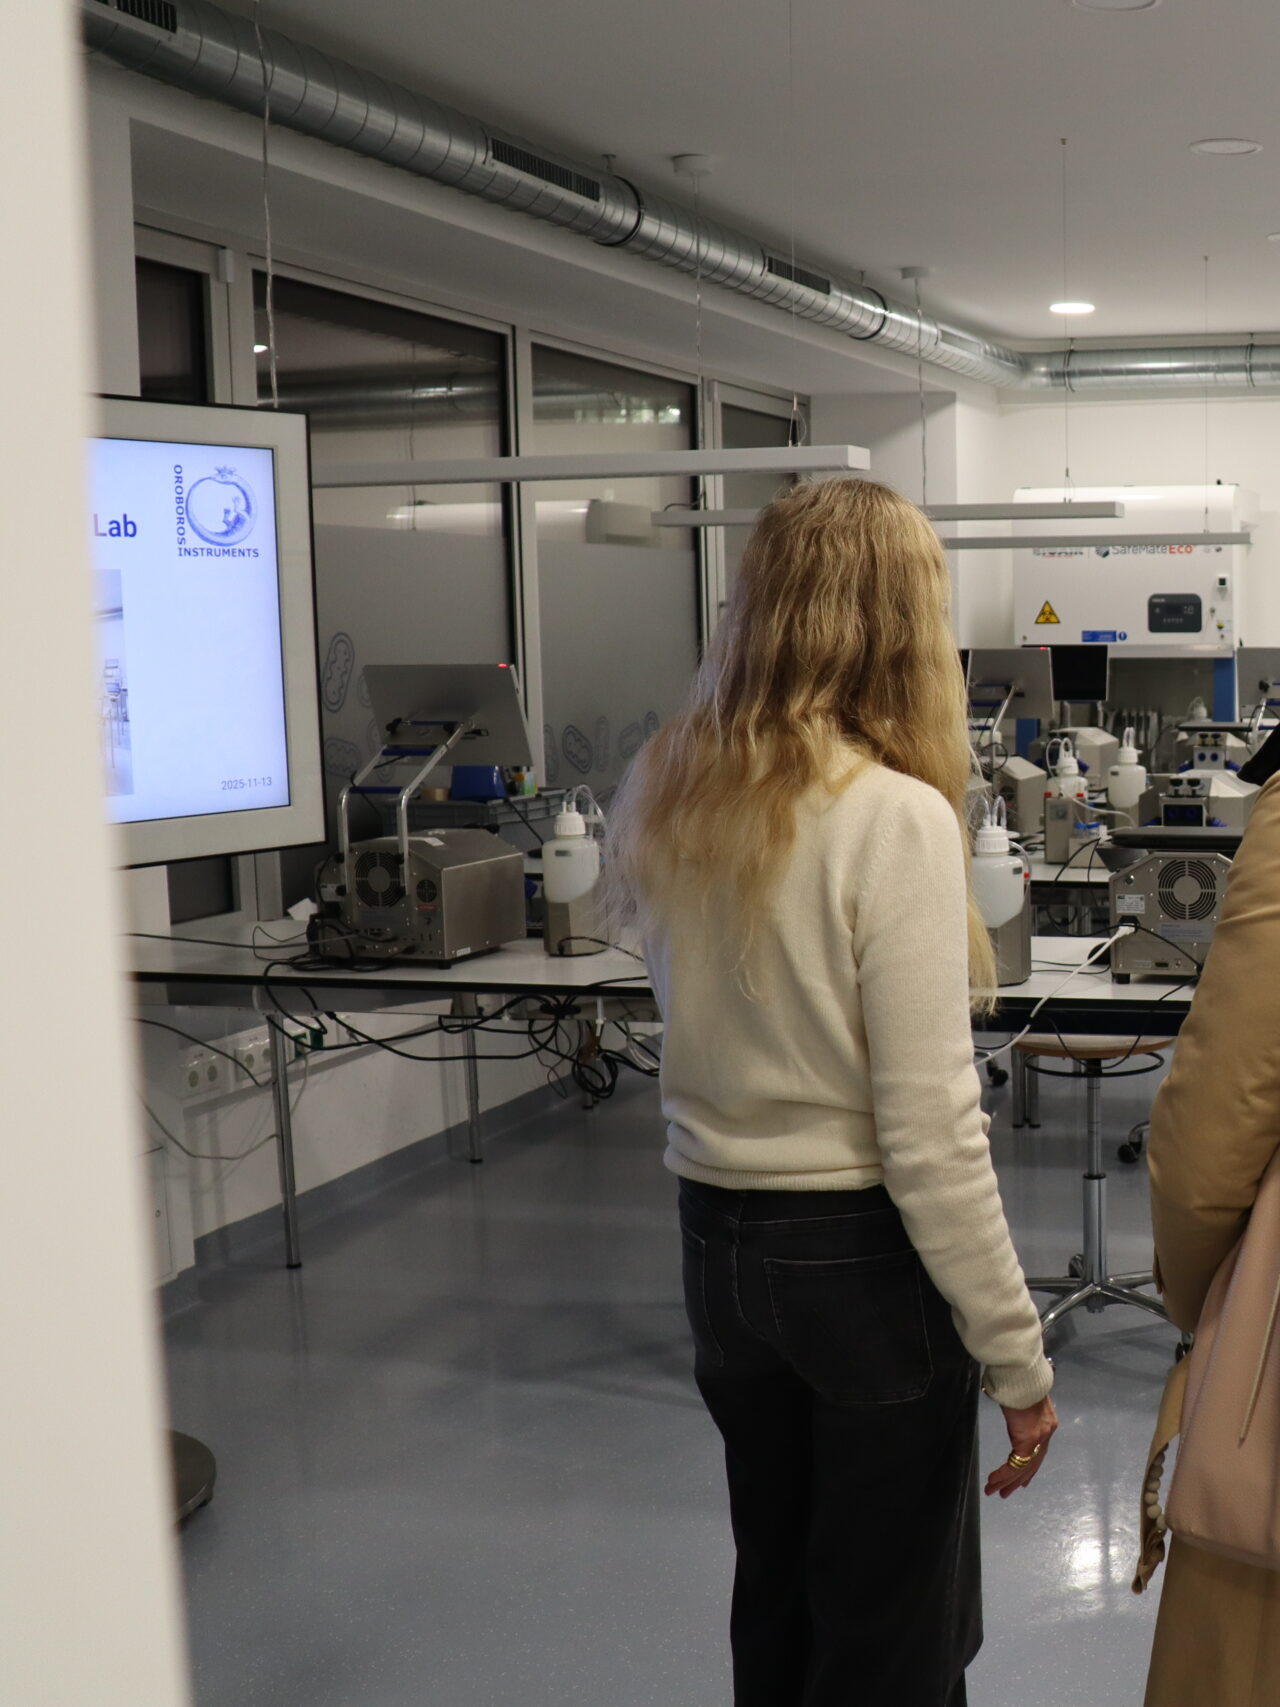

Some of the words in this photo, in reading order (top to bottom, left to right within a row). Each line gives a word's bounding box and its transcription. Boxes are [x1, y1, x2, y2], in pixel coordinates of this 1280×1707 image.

[173, 464, 186, 545] OROBOROS
[93, 513, 137, 538] Lab
[178, 547, 259, 558] INSTRUMENTS
[221, 776, 272, 791] 2025-11-13
